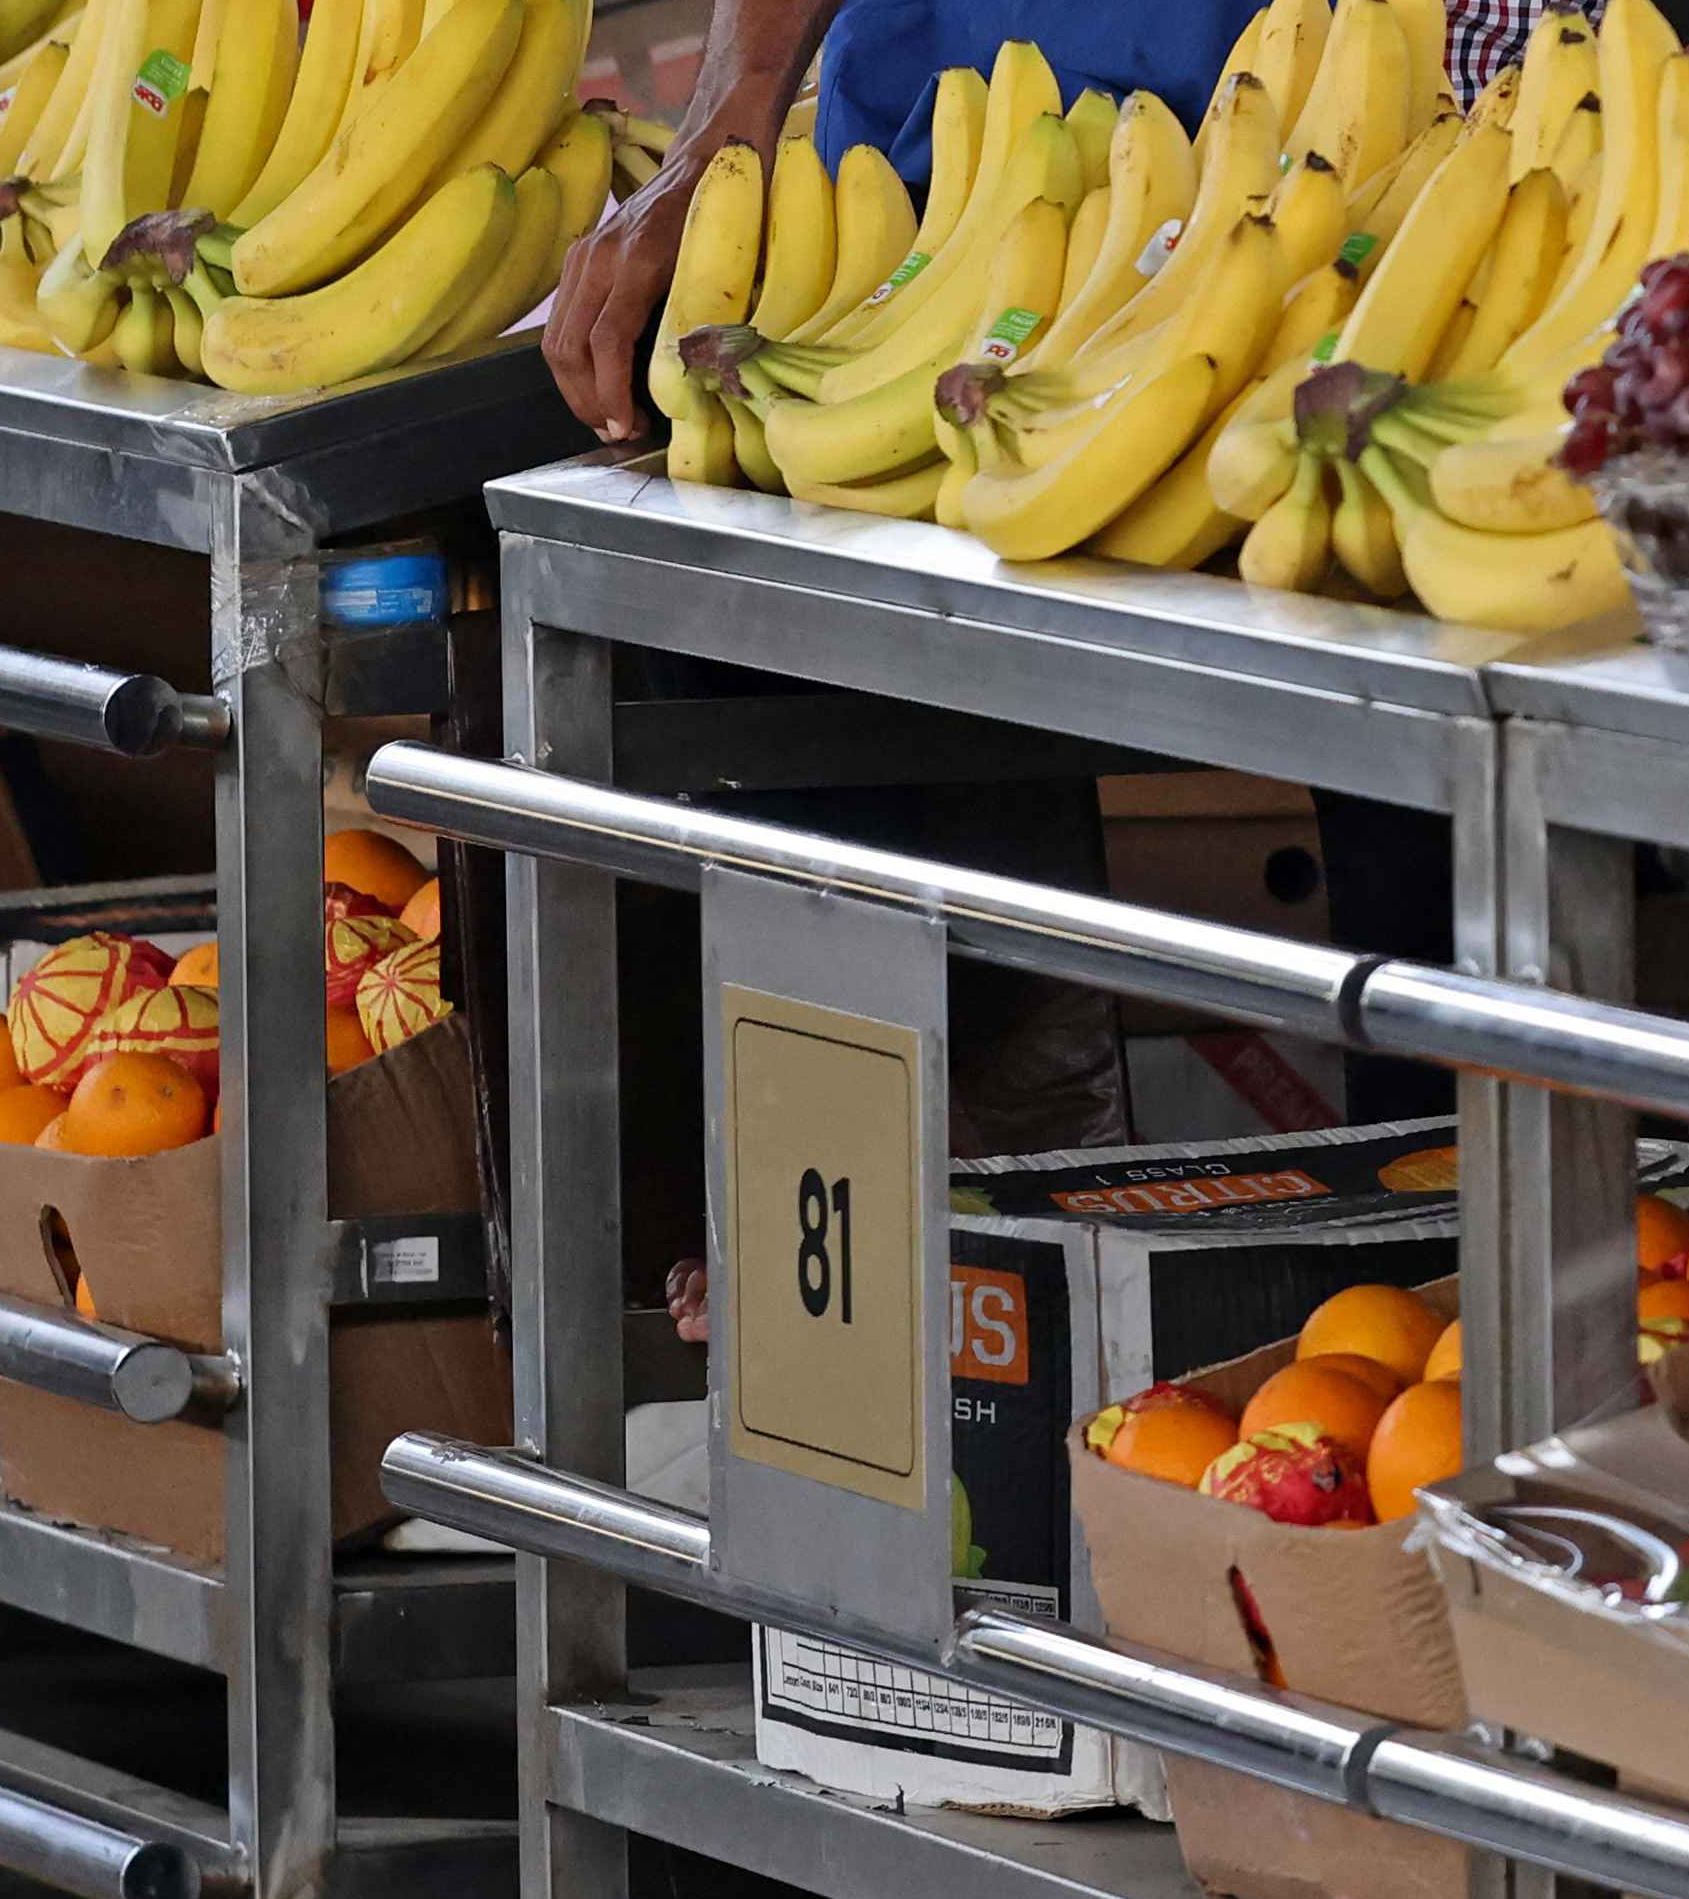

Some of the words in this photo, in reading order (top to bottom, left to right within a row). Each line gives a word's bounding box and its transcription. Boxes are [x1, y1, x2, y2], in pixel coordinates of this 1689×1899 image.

[1126, 1162, 1233, 1183] CLASS
[1067, 1170, 1312, 1214] CITRUS
[797, 1165, 852, 1325] 81
[954, 1396, 997, 1425] SH
